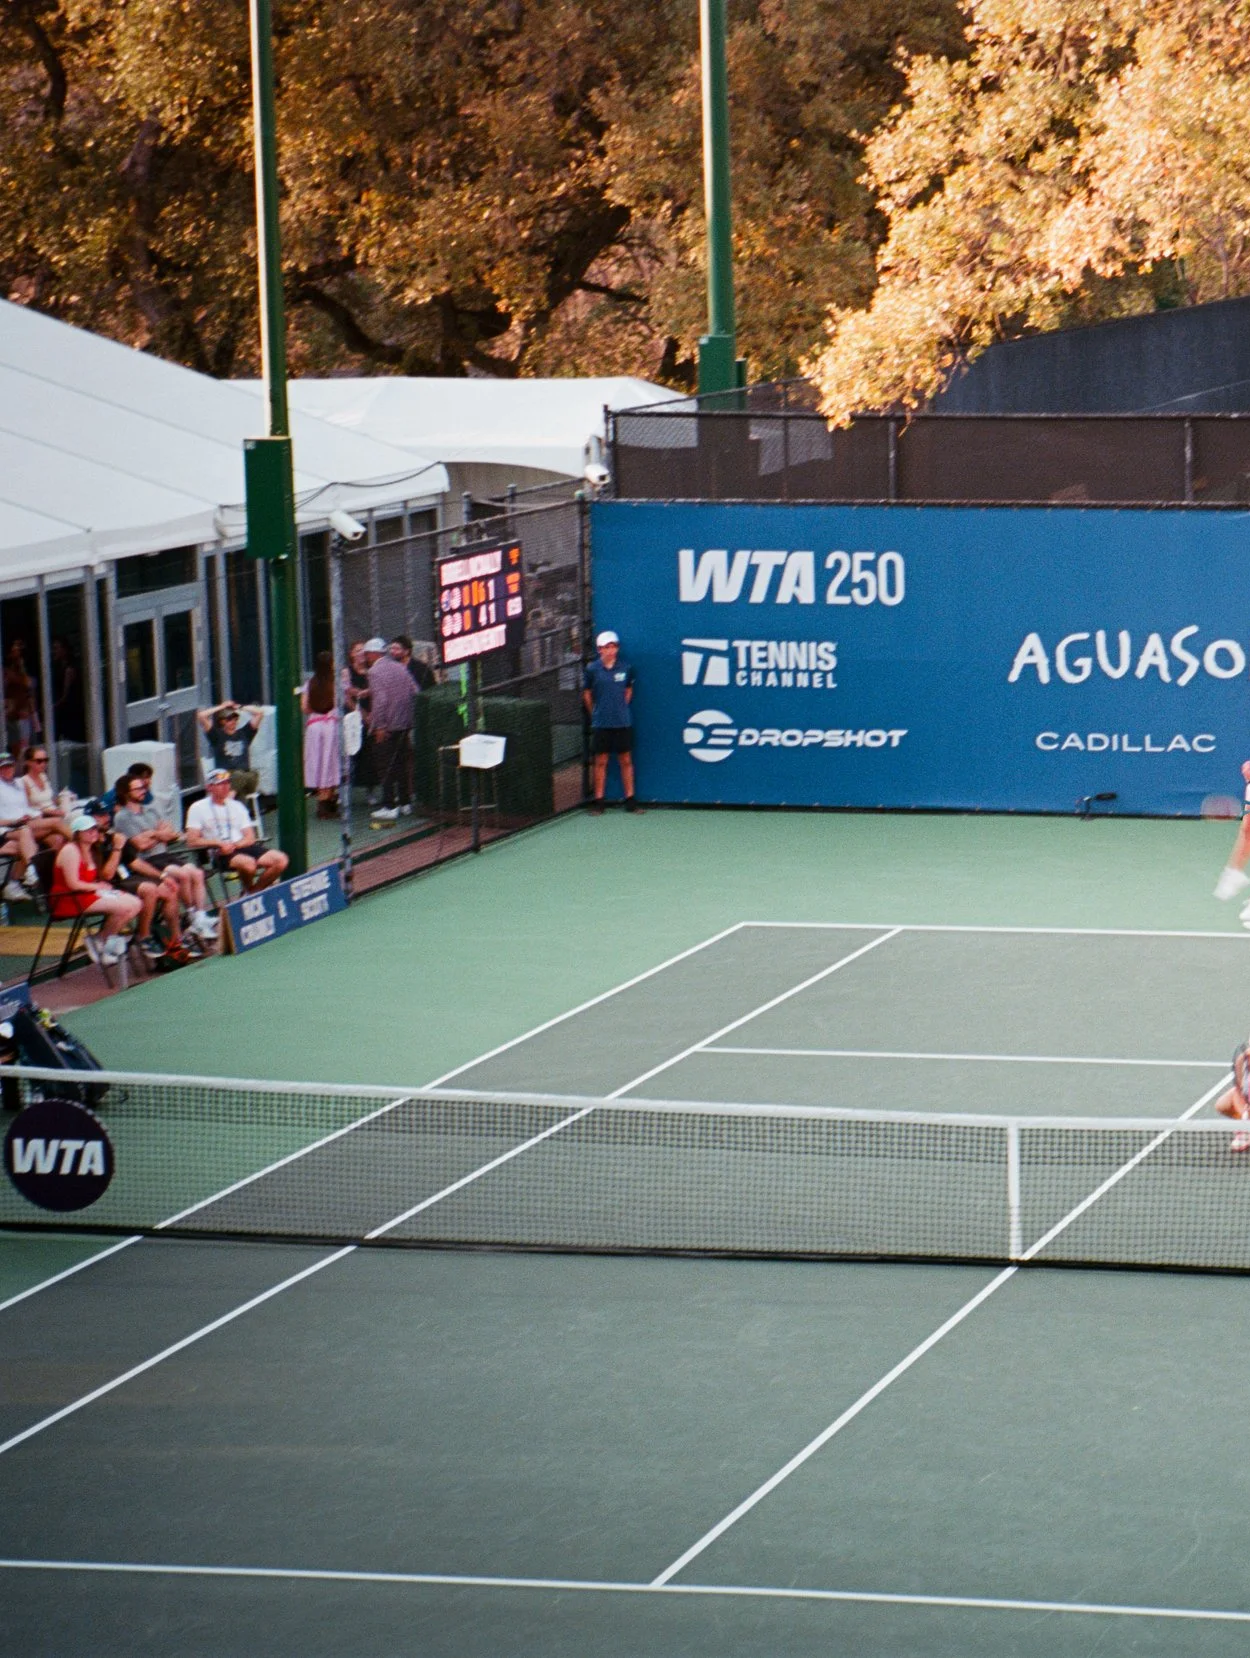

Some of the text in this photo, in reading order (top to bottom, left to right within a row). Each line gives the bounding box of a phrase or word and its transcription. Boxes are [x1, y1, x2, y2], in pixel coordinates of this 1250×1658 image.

[679, 550, 905, 606] WTA 250
[732, 639, 836, 671] TENNIS
[735, 670, 837, 689] CHANNEL
[738, 728, 908, 747] DROPSHOT
[1035, 732, 1216, 753] CADILLAC
[13, 1138, 104, 1176] WTA
